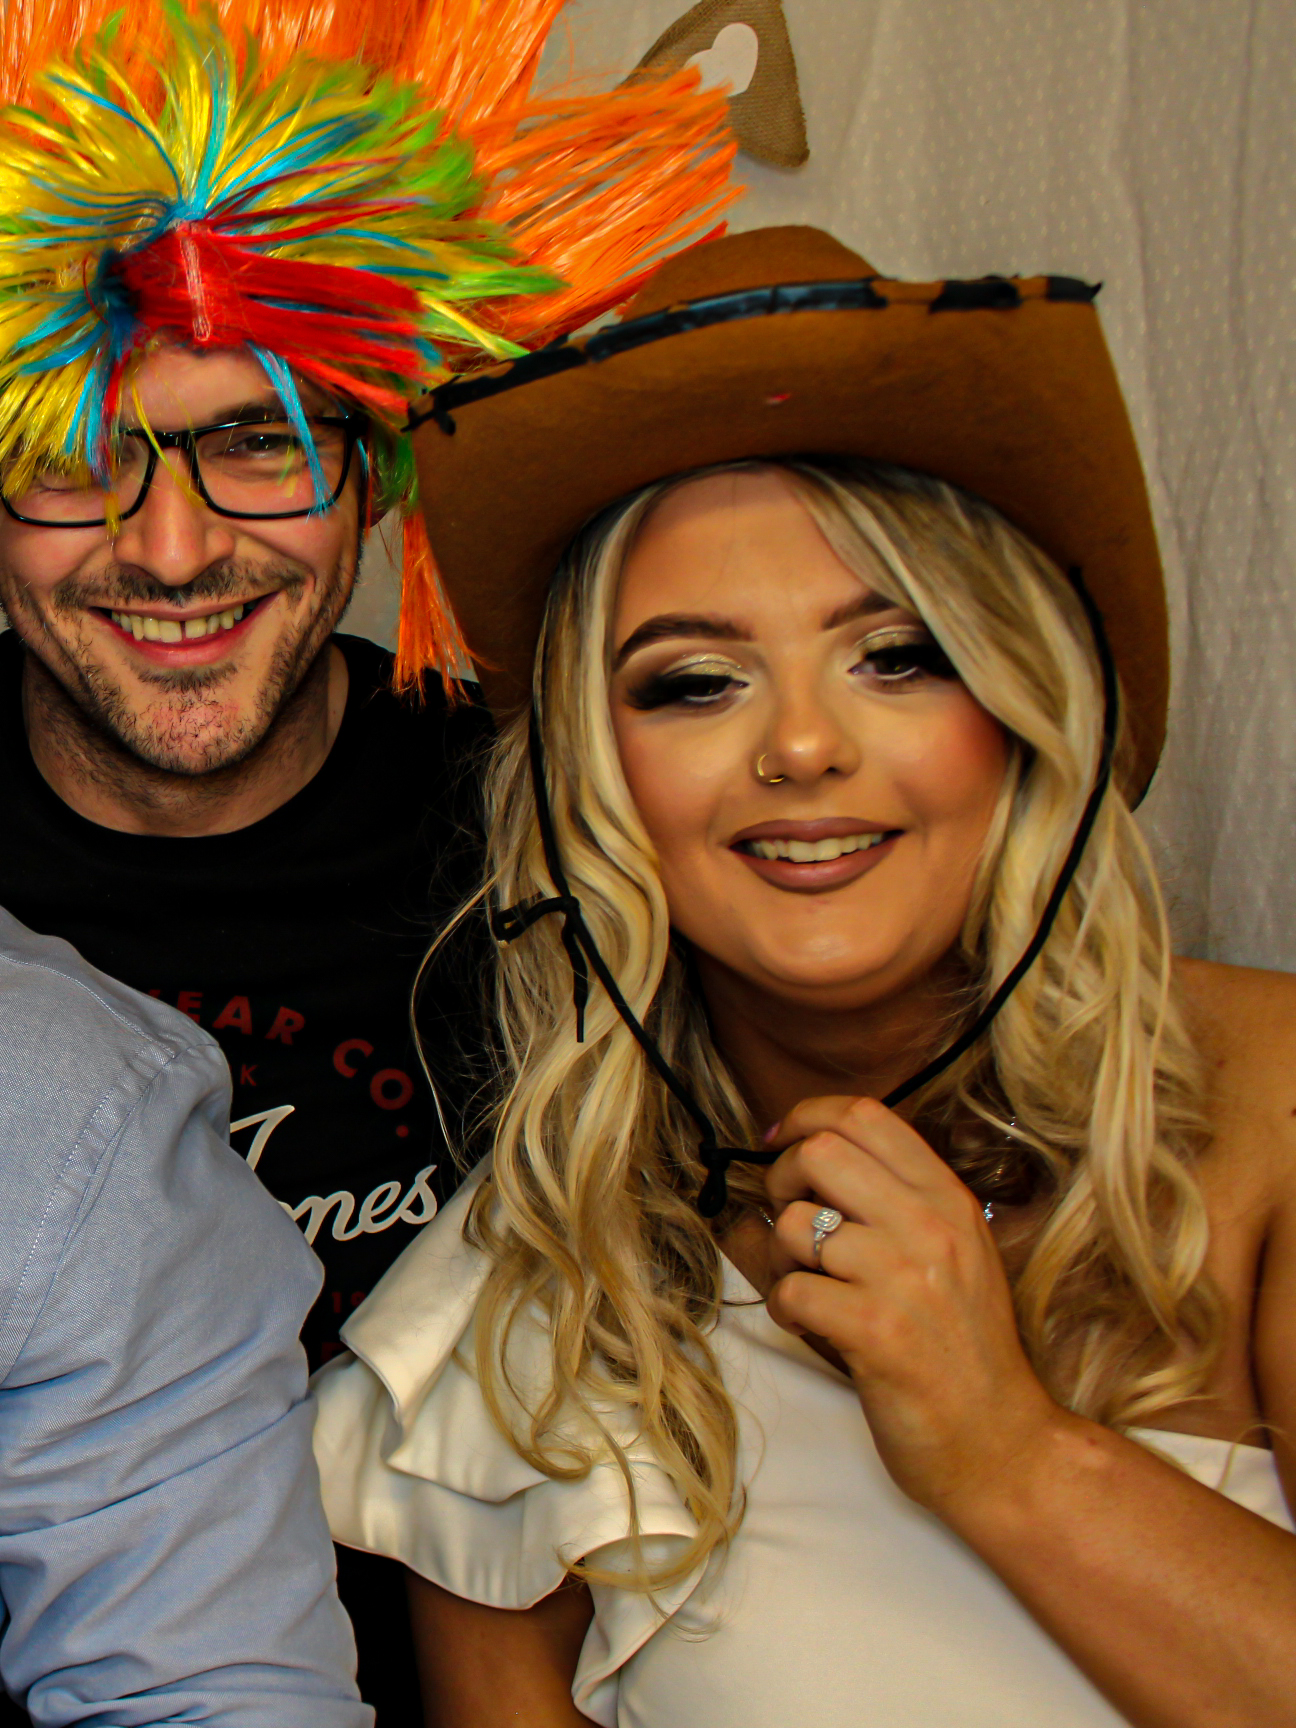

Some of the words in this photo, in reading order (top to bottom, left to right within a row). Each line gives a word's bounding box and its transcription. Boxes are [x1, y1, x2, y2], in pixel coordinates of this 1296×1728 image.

[148, 989, 305, 1045] EAR
[333, 1038, 414, 1138] CO.
[230, 1104, 437, 1247] nes
